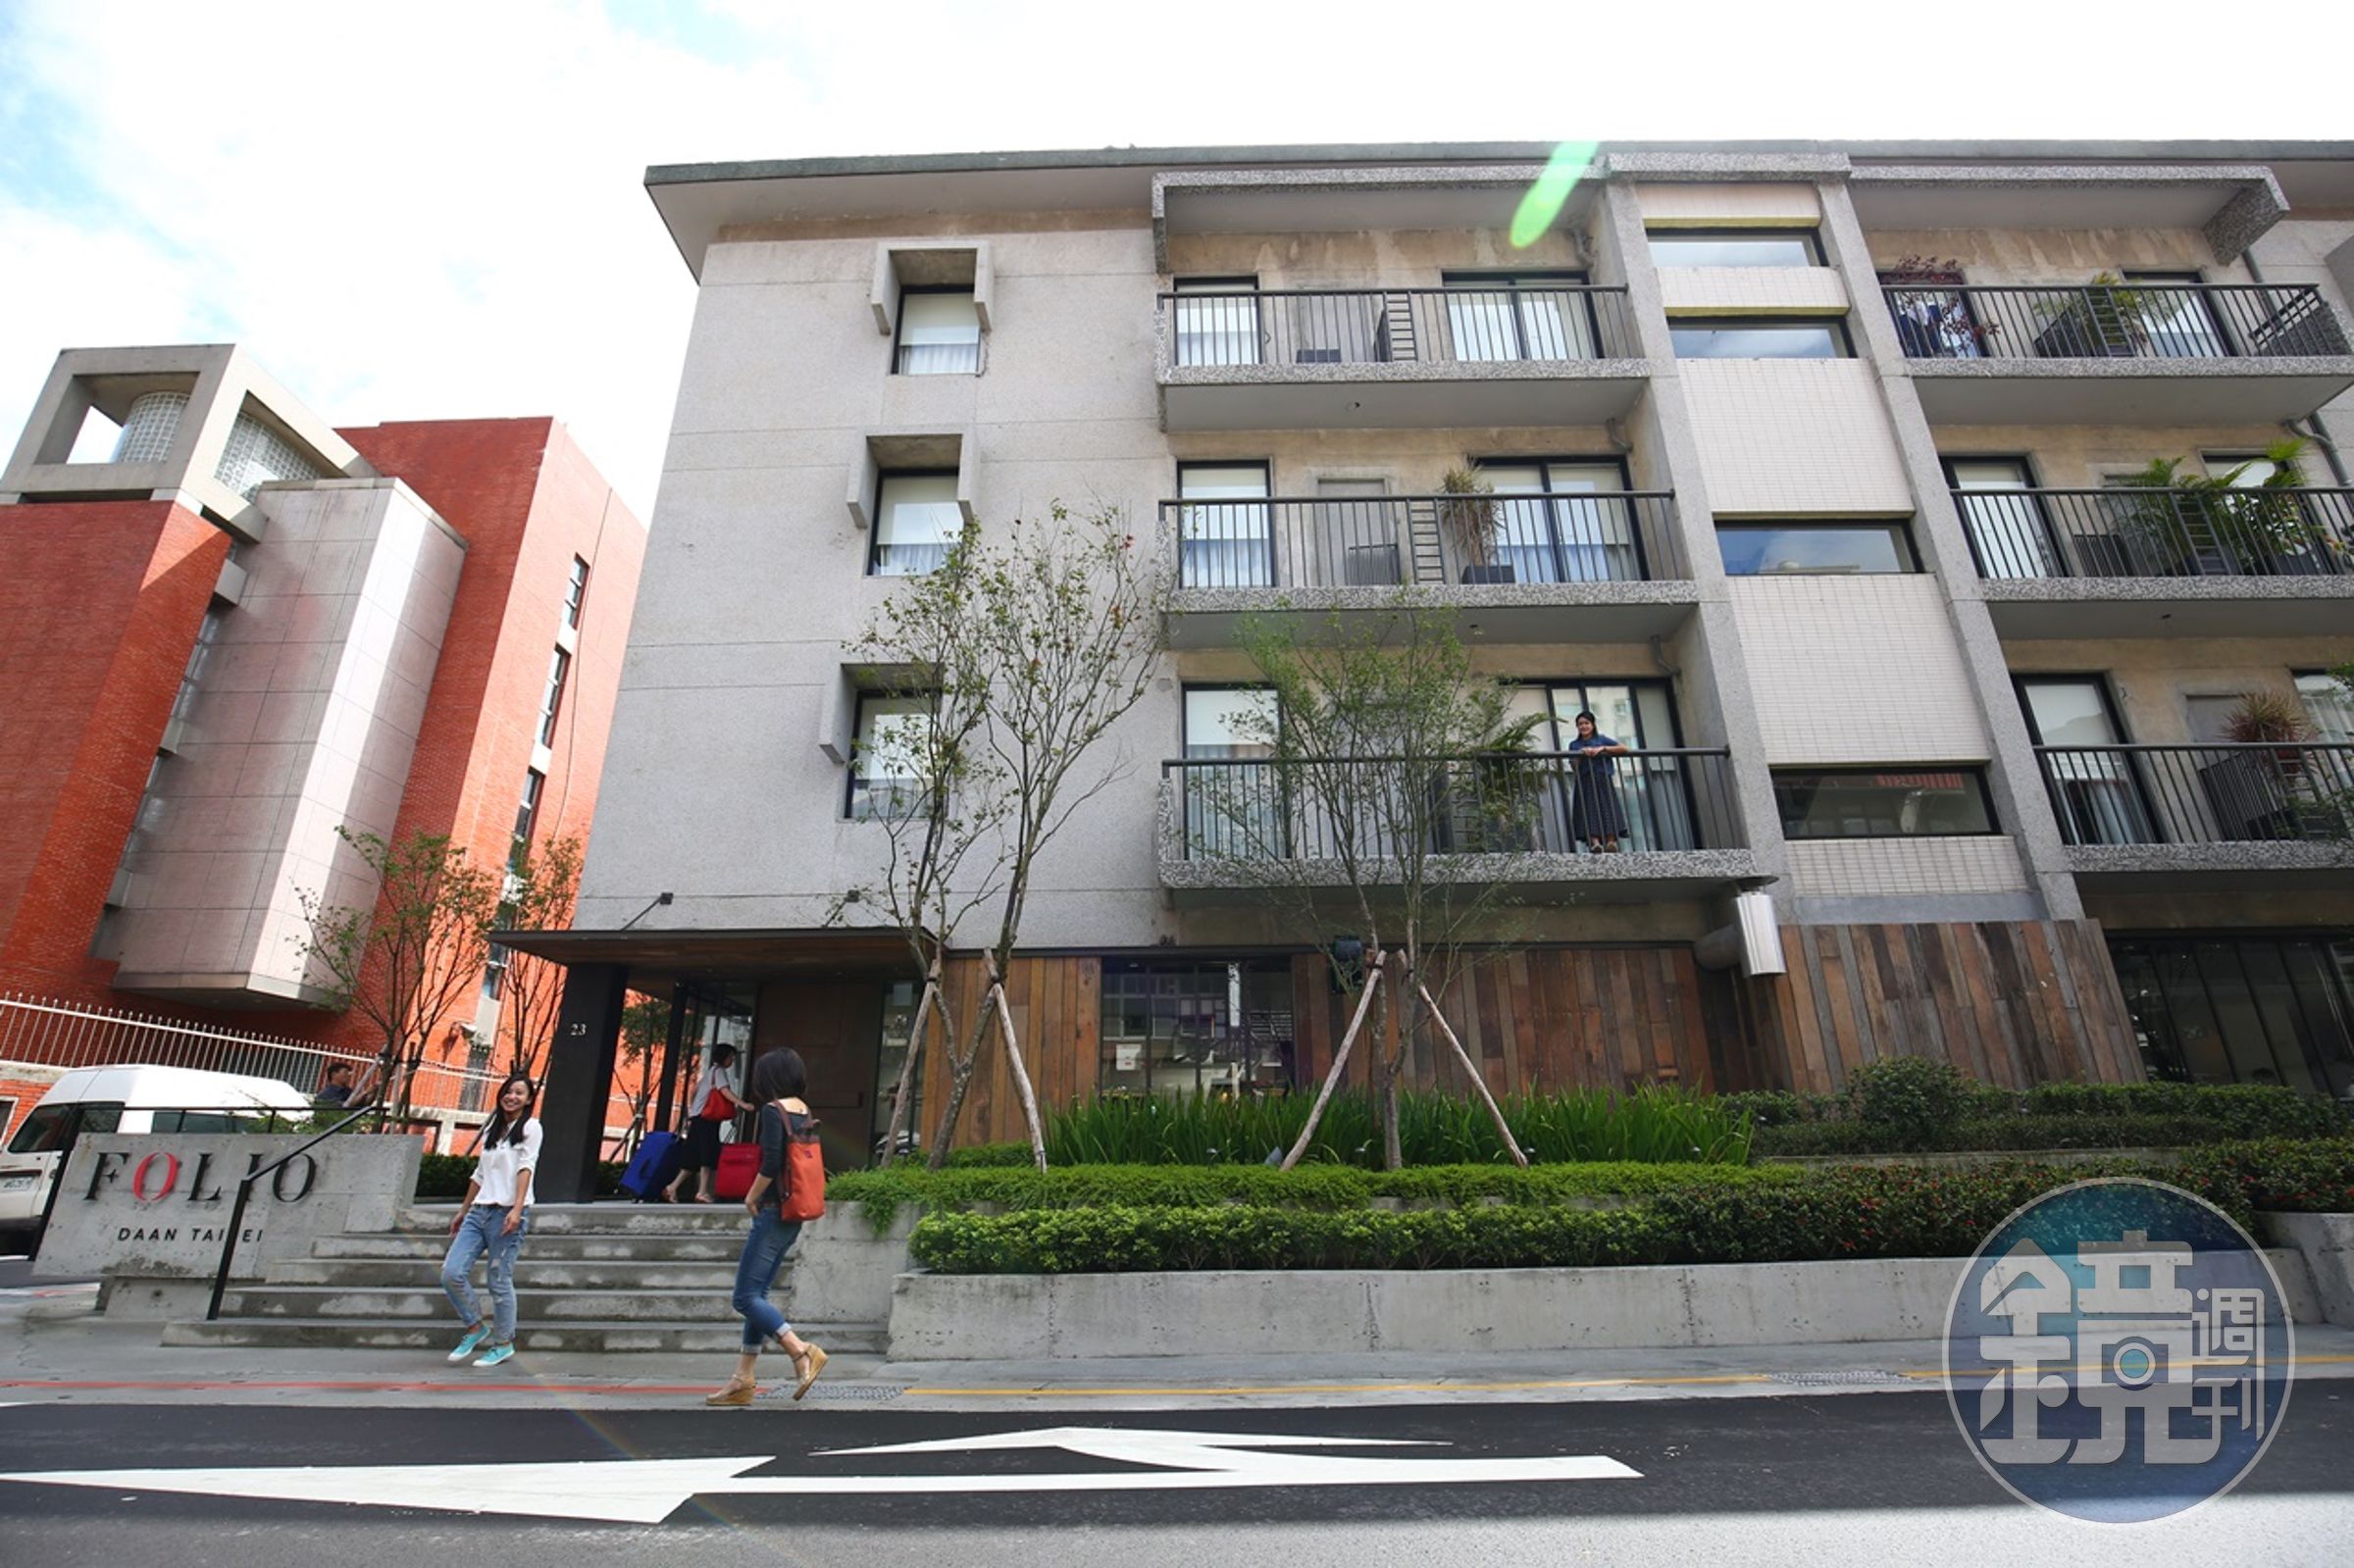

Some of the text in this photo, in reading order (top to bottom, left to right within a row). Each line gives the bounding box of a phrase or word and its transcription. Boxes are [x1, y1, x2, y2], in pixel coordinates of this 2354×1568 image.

[570, 1023, 587, 1037] 23
[117, 1227, 263, 1243] DAAN TAIEI
